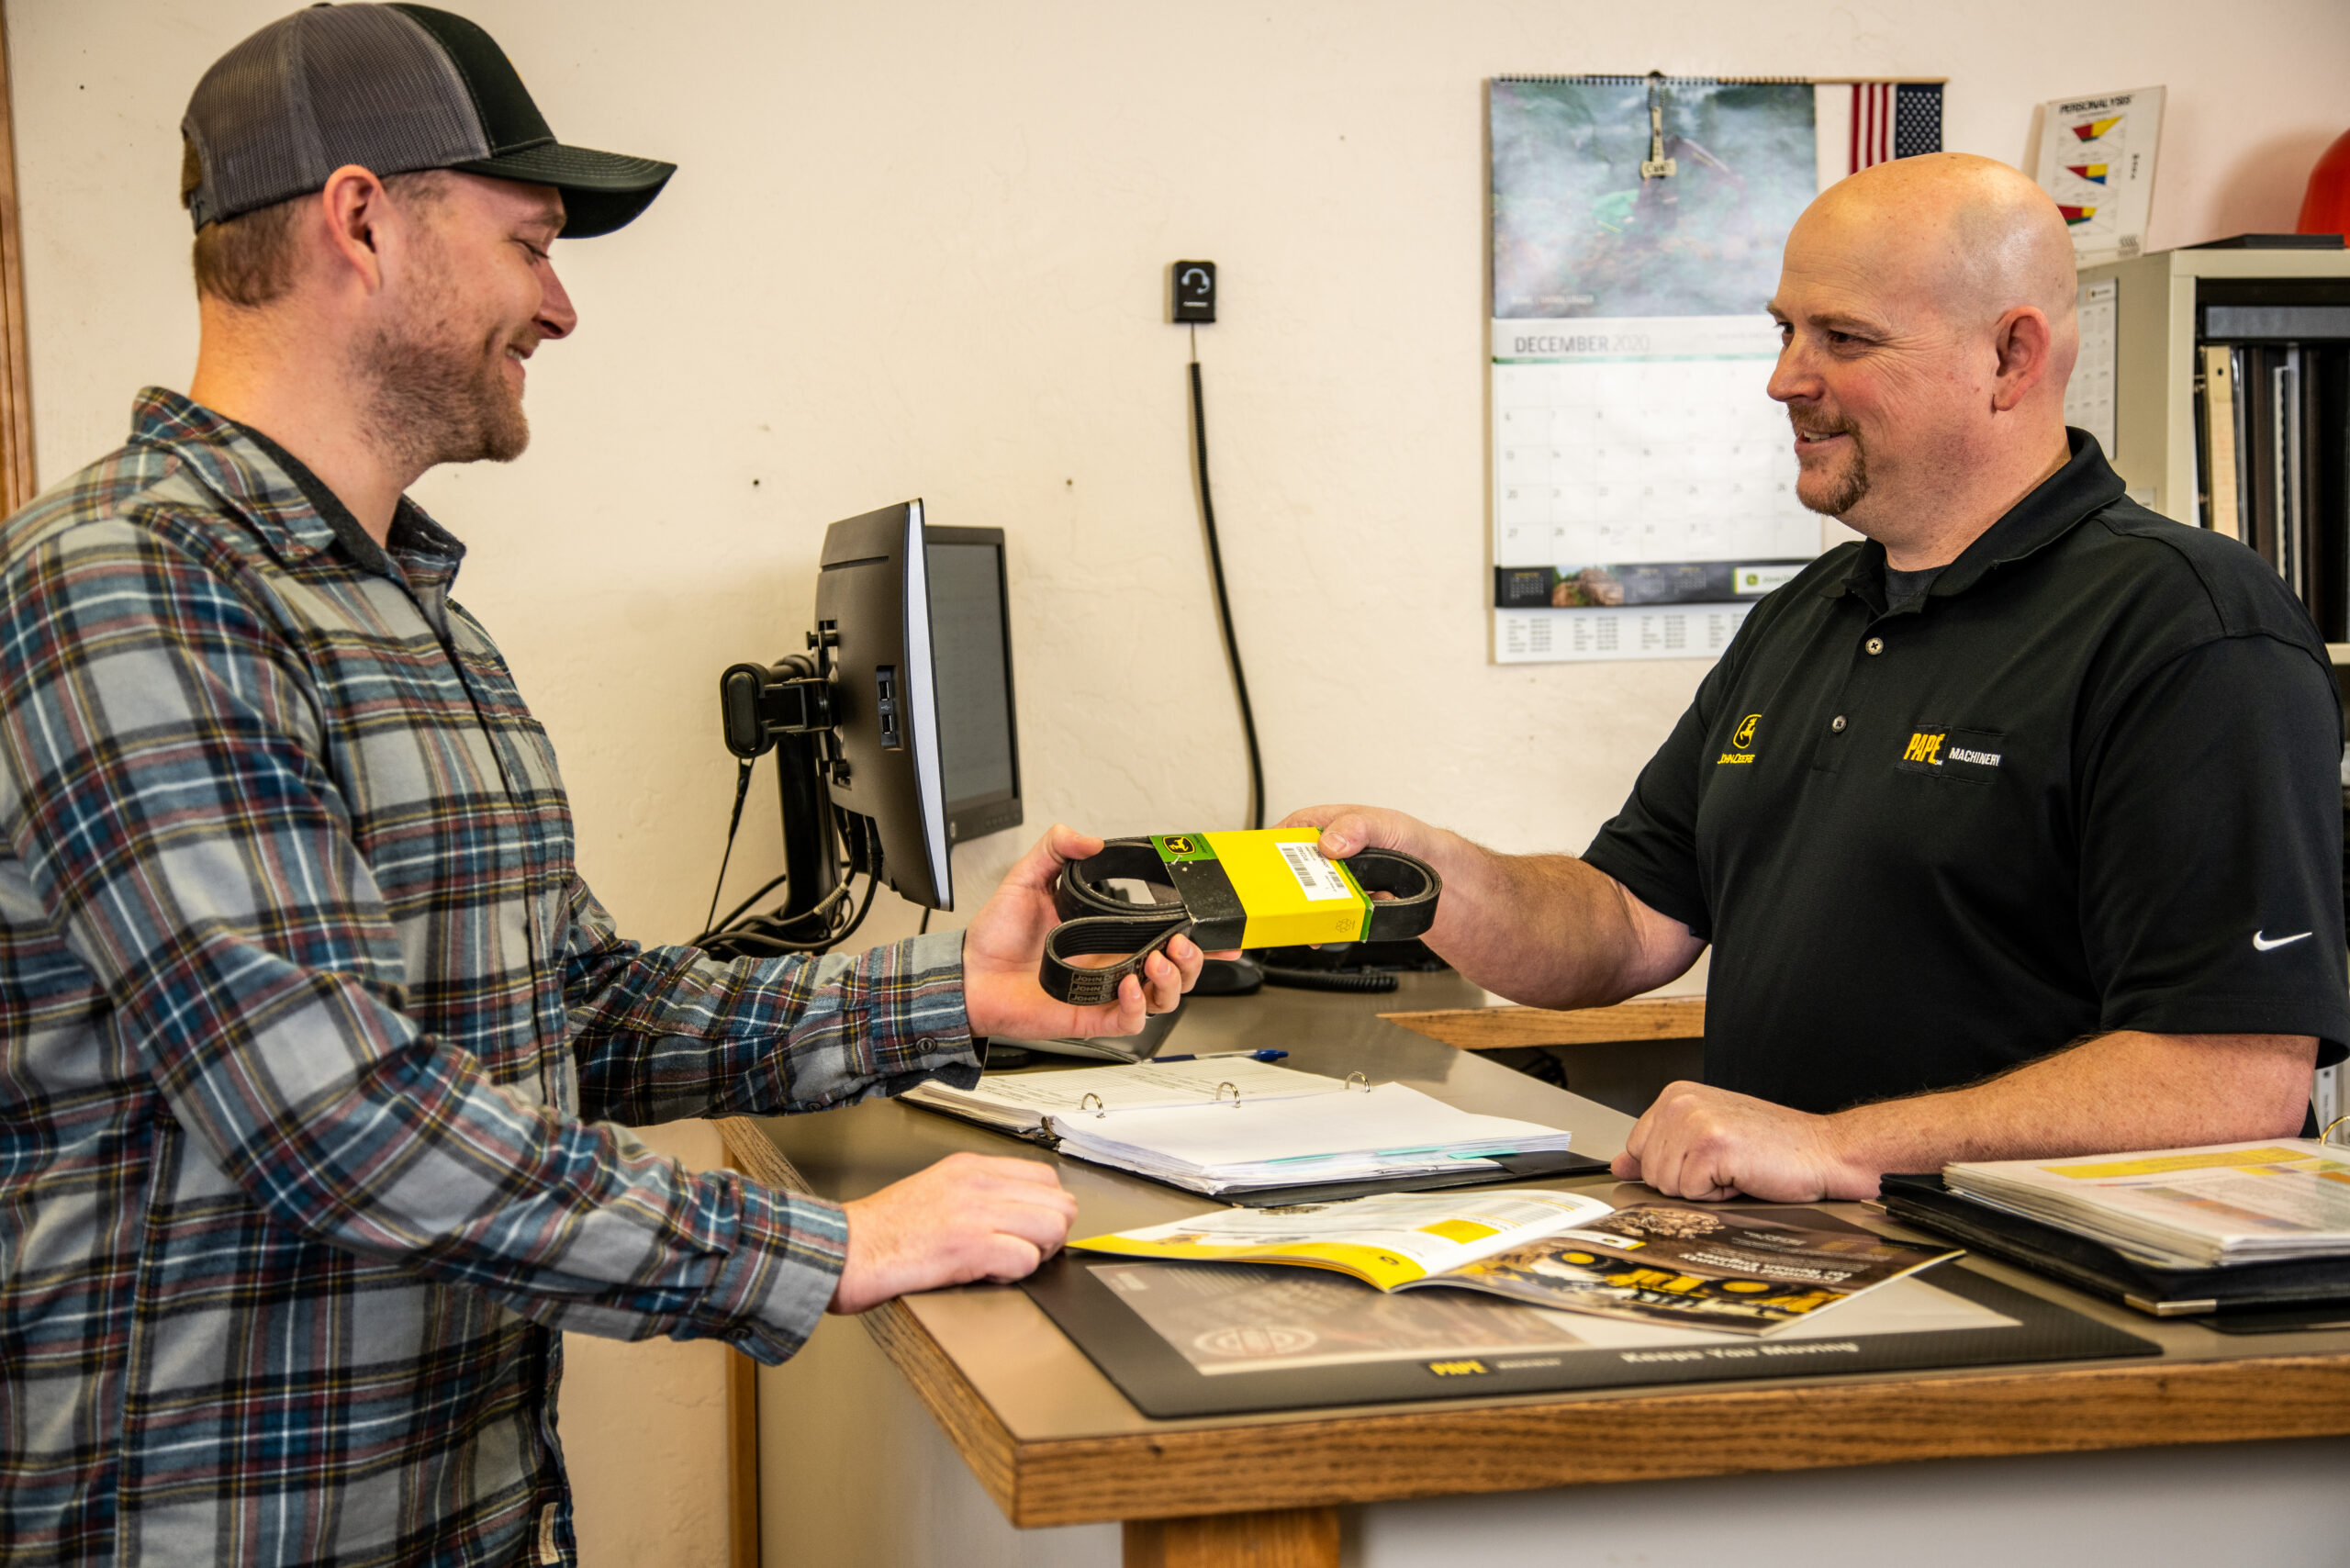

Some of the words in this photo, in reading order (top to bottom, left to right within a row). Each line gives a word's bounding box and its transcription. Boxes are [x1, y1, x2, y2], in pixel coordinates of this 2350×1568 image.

[1515, 336, 1608, 353] DECEMBER
[1612, 334, 1651, 353] 2020
[1949, 746, 2001, 767] MACHINERY
[1076, 974, 1102, 982] JOHN
[1073, 983, 1101, 991] JOHN
[1071, 993, 1099, 1002] JOHN
[1620, 1350, 1705, 1363] Keeps
[1705, 1347, 1758, 1359] You
[1760, 1342, 1860, 1356] Moving
